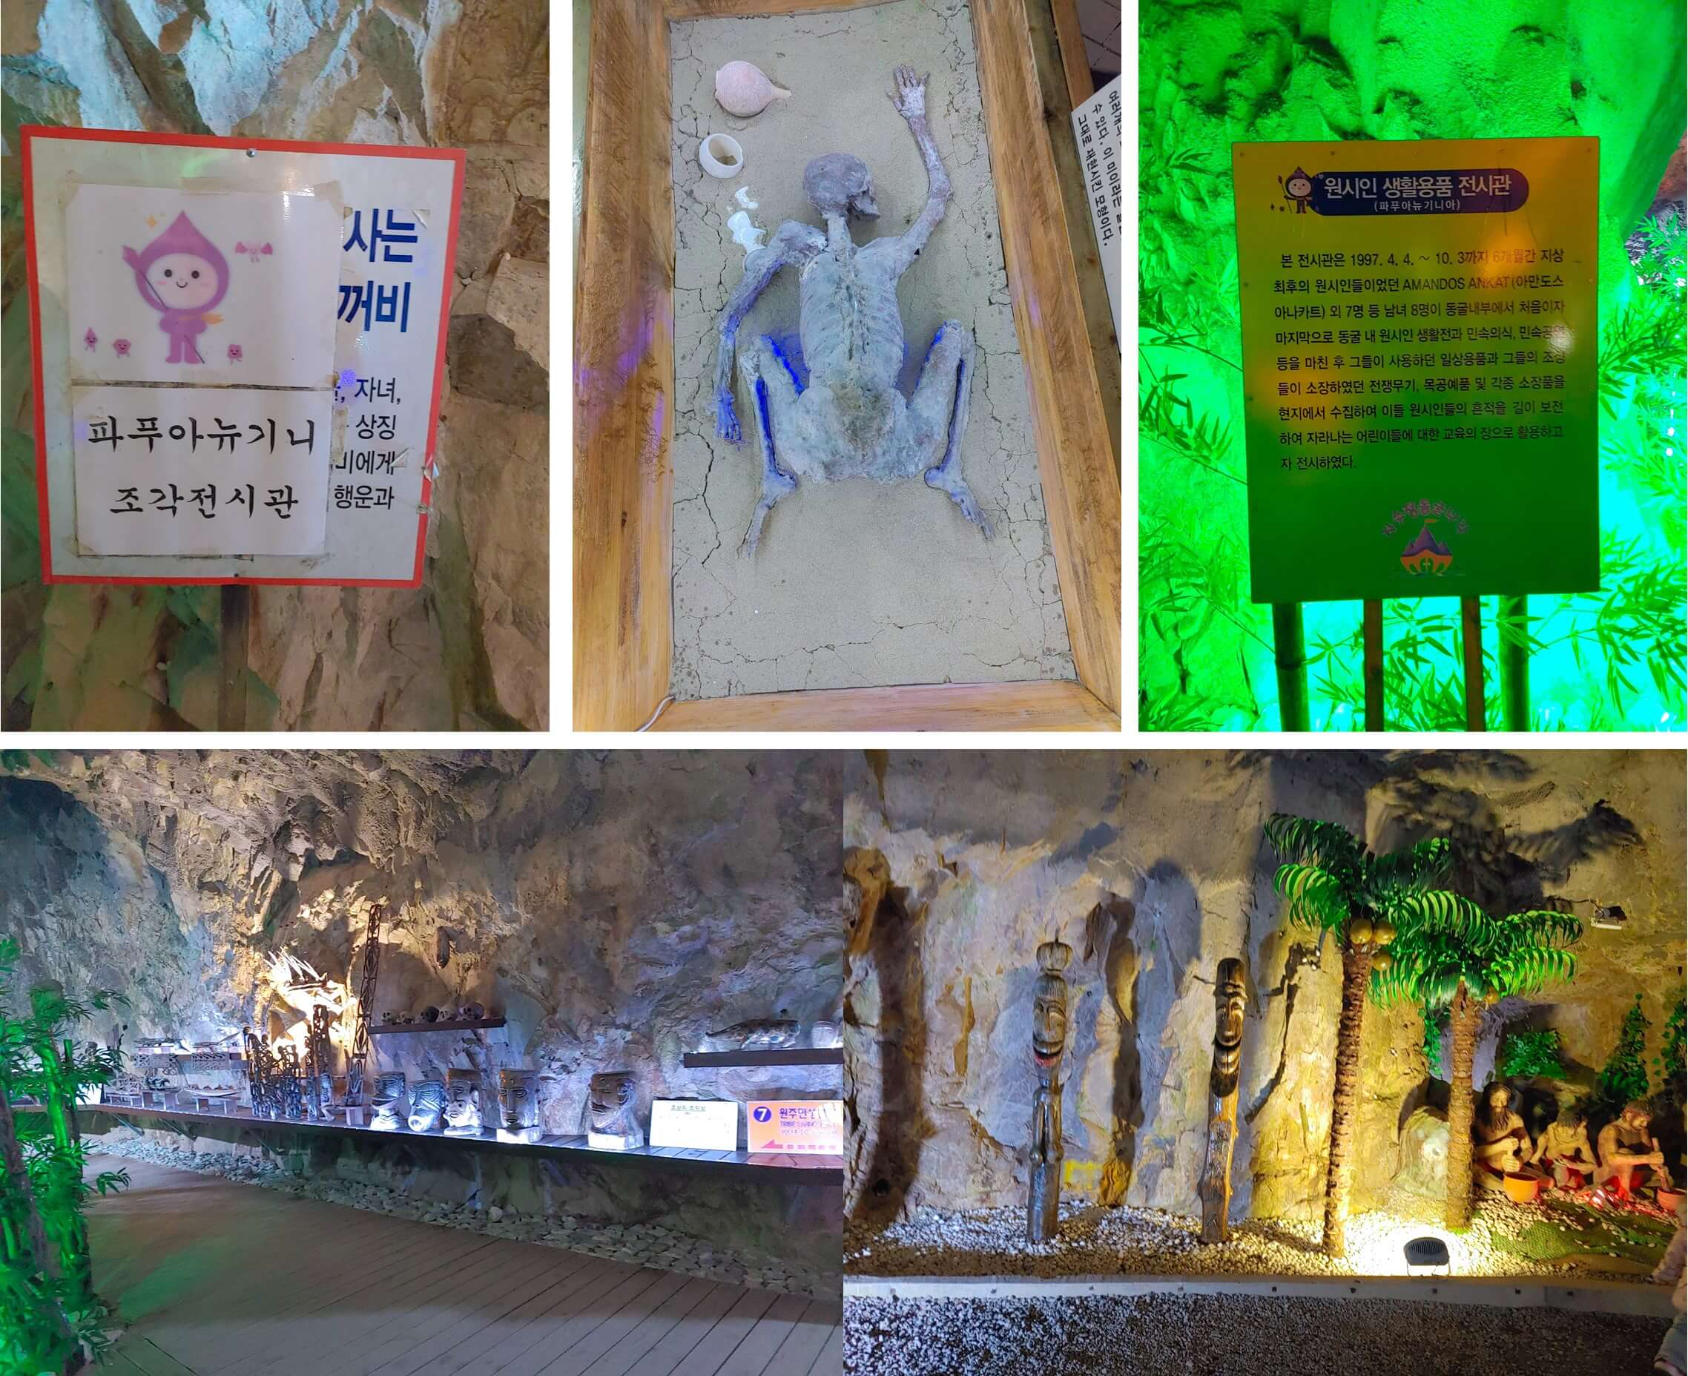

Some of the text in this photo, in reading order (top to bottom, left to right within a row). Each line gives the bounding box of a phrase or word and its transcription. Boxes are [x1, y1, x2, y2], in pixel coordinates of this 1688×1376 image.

[1092, 103, 1103, 114] 수
[1095, 115, 1109, 145] 있다.
[1103, 147, 1114, 160] 이
[1078, 114, 1114, 246] 그대로 재현시킨 모형이다.
[1106, 161, 1121, 208] 미이라는
[1324, 174, 1512, 199] 원시인 생활용품 전시관
[1374, 199, 1460, 213] (파푸아뉴기니아)
[343, 208, 418, 263] 사는
[1281, 254, 1293, 268] 본
[1298, 253, 1345, 268] 전시관은
[1351, 253, 1383, 267] 1997.
[1387, 253, 1398, 266] 4.
[1403, 253, 1414, 266] 4.
[1436, 252, 1452, 265] 10.
[1457, 250, 1488, 265] 3까지
[1541, 248, 1564, 263] 지상
[1274, 279, 1310, 294] 최후의
[1315, 278, 1399, 294] 원시인들이었던
[1403, 277, 1465, 291] AMANDOS
[1275, 299, 1565, 320] 아나카트) 외 7명 등 남녀 8명이 동굴내부에서 처음이자
[1276, 331, 1334, 345] 마지막으로
[1338, 330, 1361, 344] 동굴
[1365, 330, 1376, 343] 내
[1379, 328, 1413, 343] 원시인
[1417, 327, 1462, 343] 생활전과
[1467, 326, 1516, 341] 민속의식,
[1276, 356, 1300, 371] 등을
[1305, 356, 1328, 370] 마친
[1333, 355, 1344, 370] 후
[1349, 354, 1384, 369] 그들이
[1389, 353, 1435, 368] 사용하던
[1440, 351, 1498, 367] 일상용품과
[1503, 351, 1538, 365] 그들의
[354, 376, 401, 404] 자녀,
[1277, 374, 1565, 396] 들이 소장하였던 전쟁무기, 목공예품 및 각종 소장품을
[1278, 400, 1564, 421] 현지에서 수집하여 이들 원시인들의 흔적을 길이 보전
[86, 415, 316, 455] 파푸아뉴기니
[355, 414, 396, 440] 상징
[1279, 425, 1564, 446] 하여 자라나는 어린이들에 대한 교육의 장으로 활용하고
[1281, 455, 1357, 471] 자 전시하였다.
[109, 483, 300, 519] 조각전시관
[334, 484, 395, 511] 행운과
